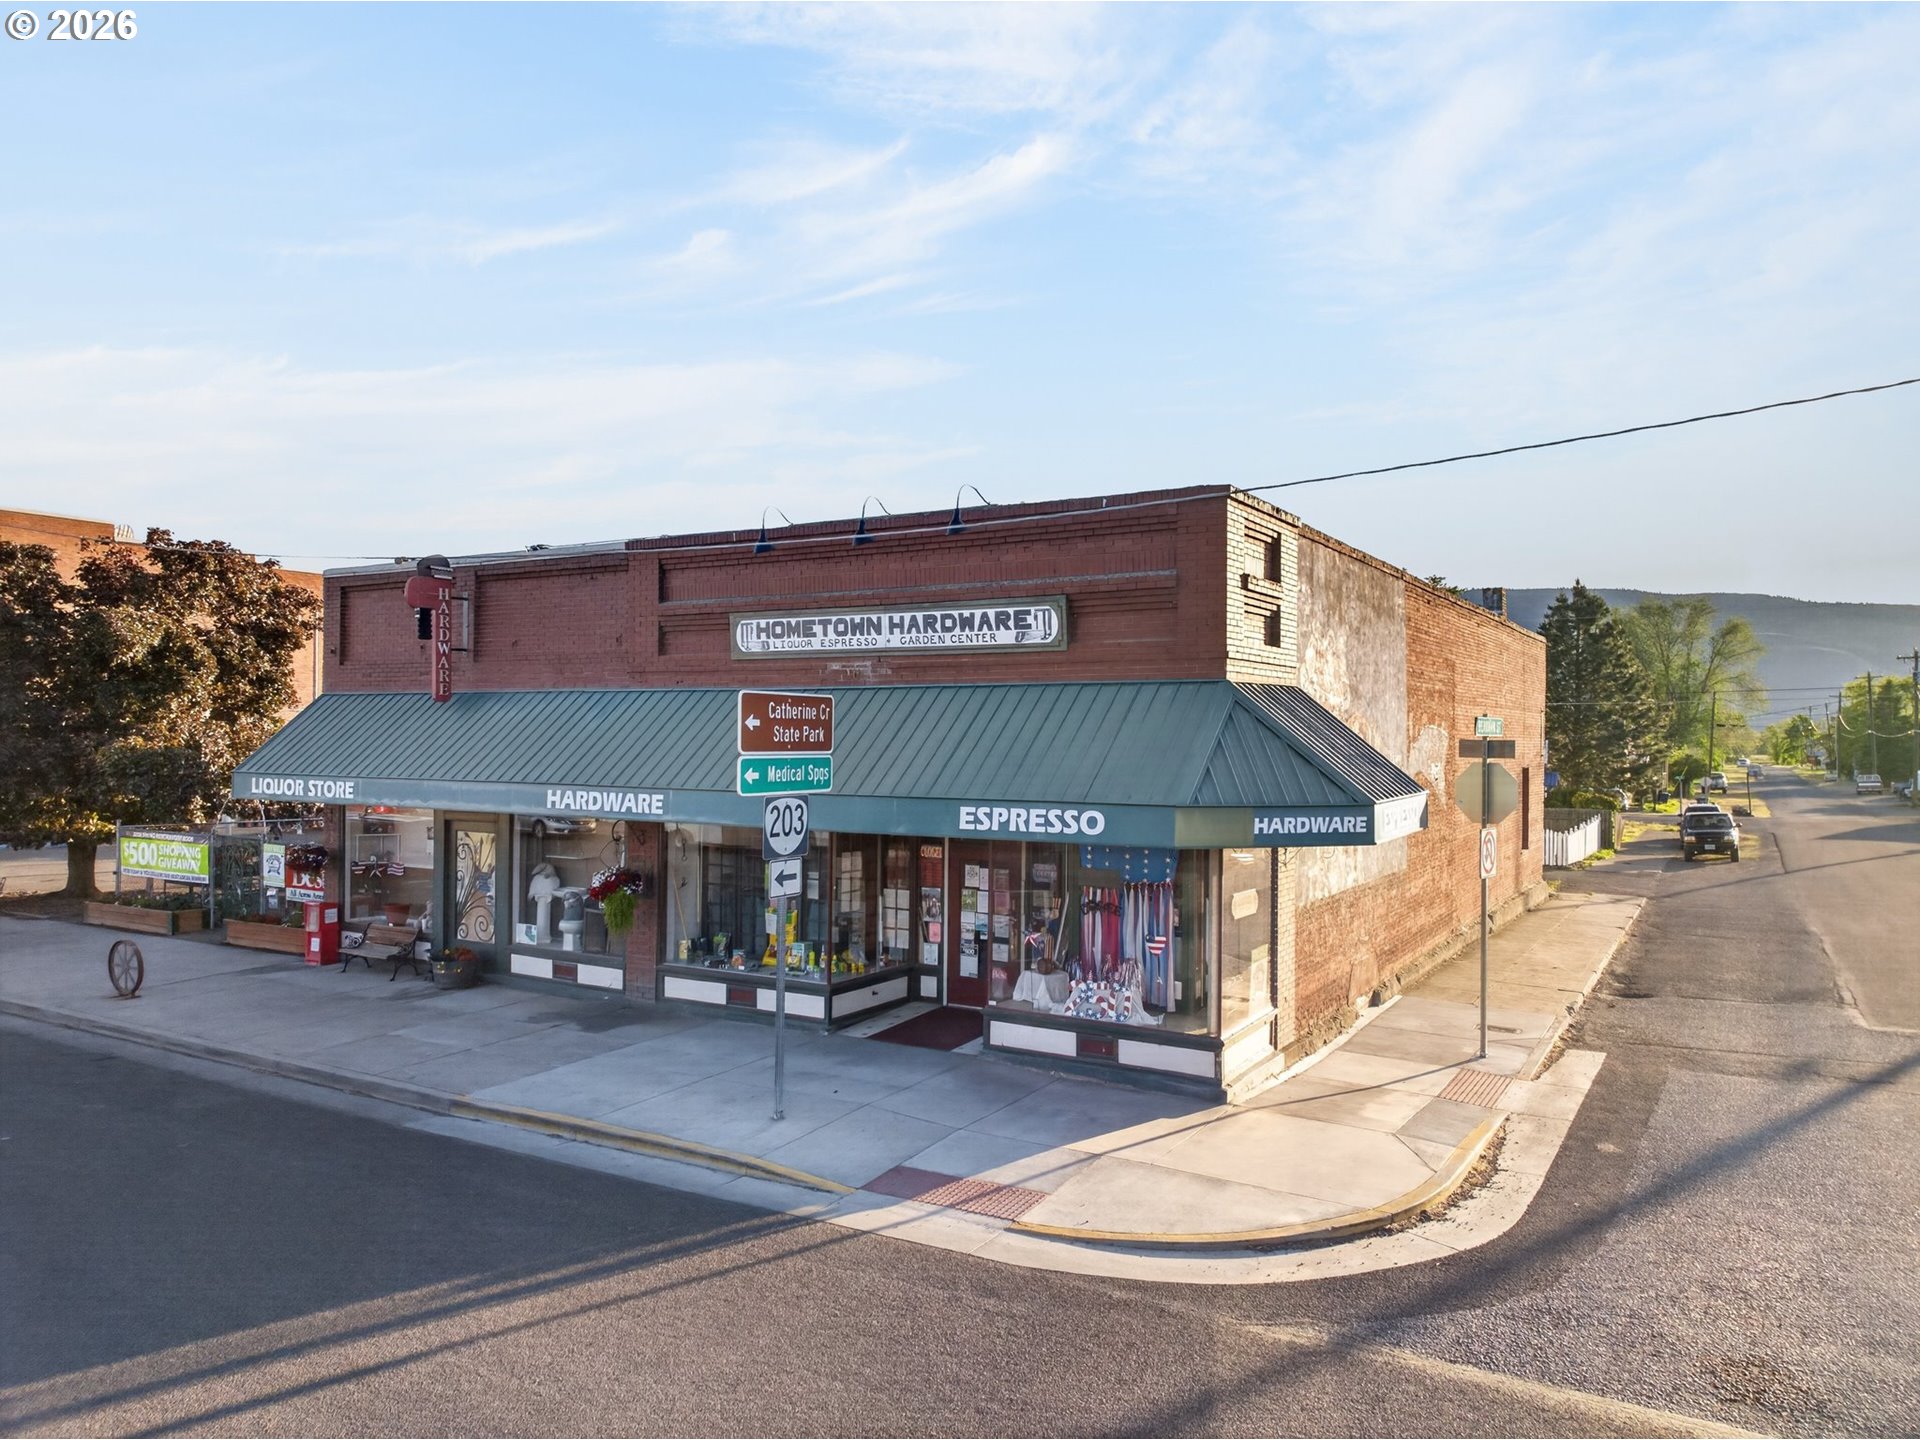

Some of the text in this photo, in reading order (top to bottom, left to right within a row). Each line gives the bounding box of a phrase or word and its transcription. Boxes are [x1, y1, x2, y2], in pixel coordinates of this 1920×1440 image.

[756, 609, 1033, 639] HOMETOWN HARDWARE
[438, 587, 451, 696] HARDWARE
[773, 632, 998, 649] LIQUOR ESPRESSO GARDEN CENTER
[768, 701, 830, 720] Catherine Cr
[773, 725, 825, 743] State Park
[767, 765, 829, 786] Medical Spgs
[251, 776, 355, 800] LIQUOR STORE
[546, 790, 665, 815] HARDWARE
[769, 803, 805, 838] 203
[959, 806, 1106, 837] ESPRESSO
[1254, 816, 1368, 835] HARDWARE
[124, 841, 158, 866] $500
